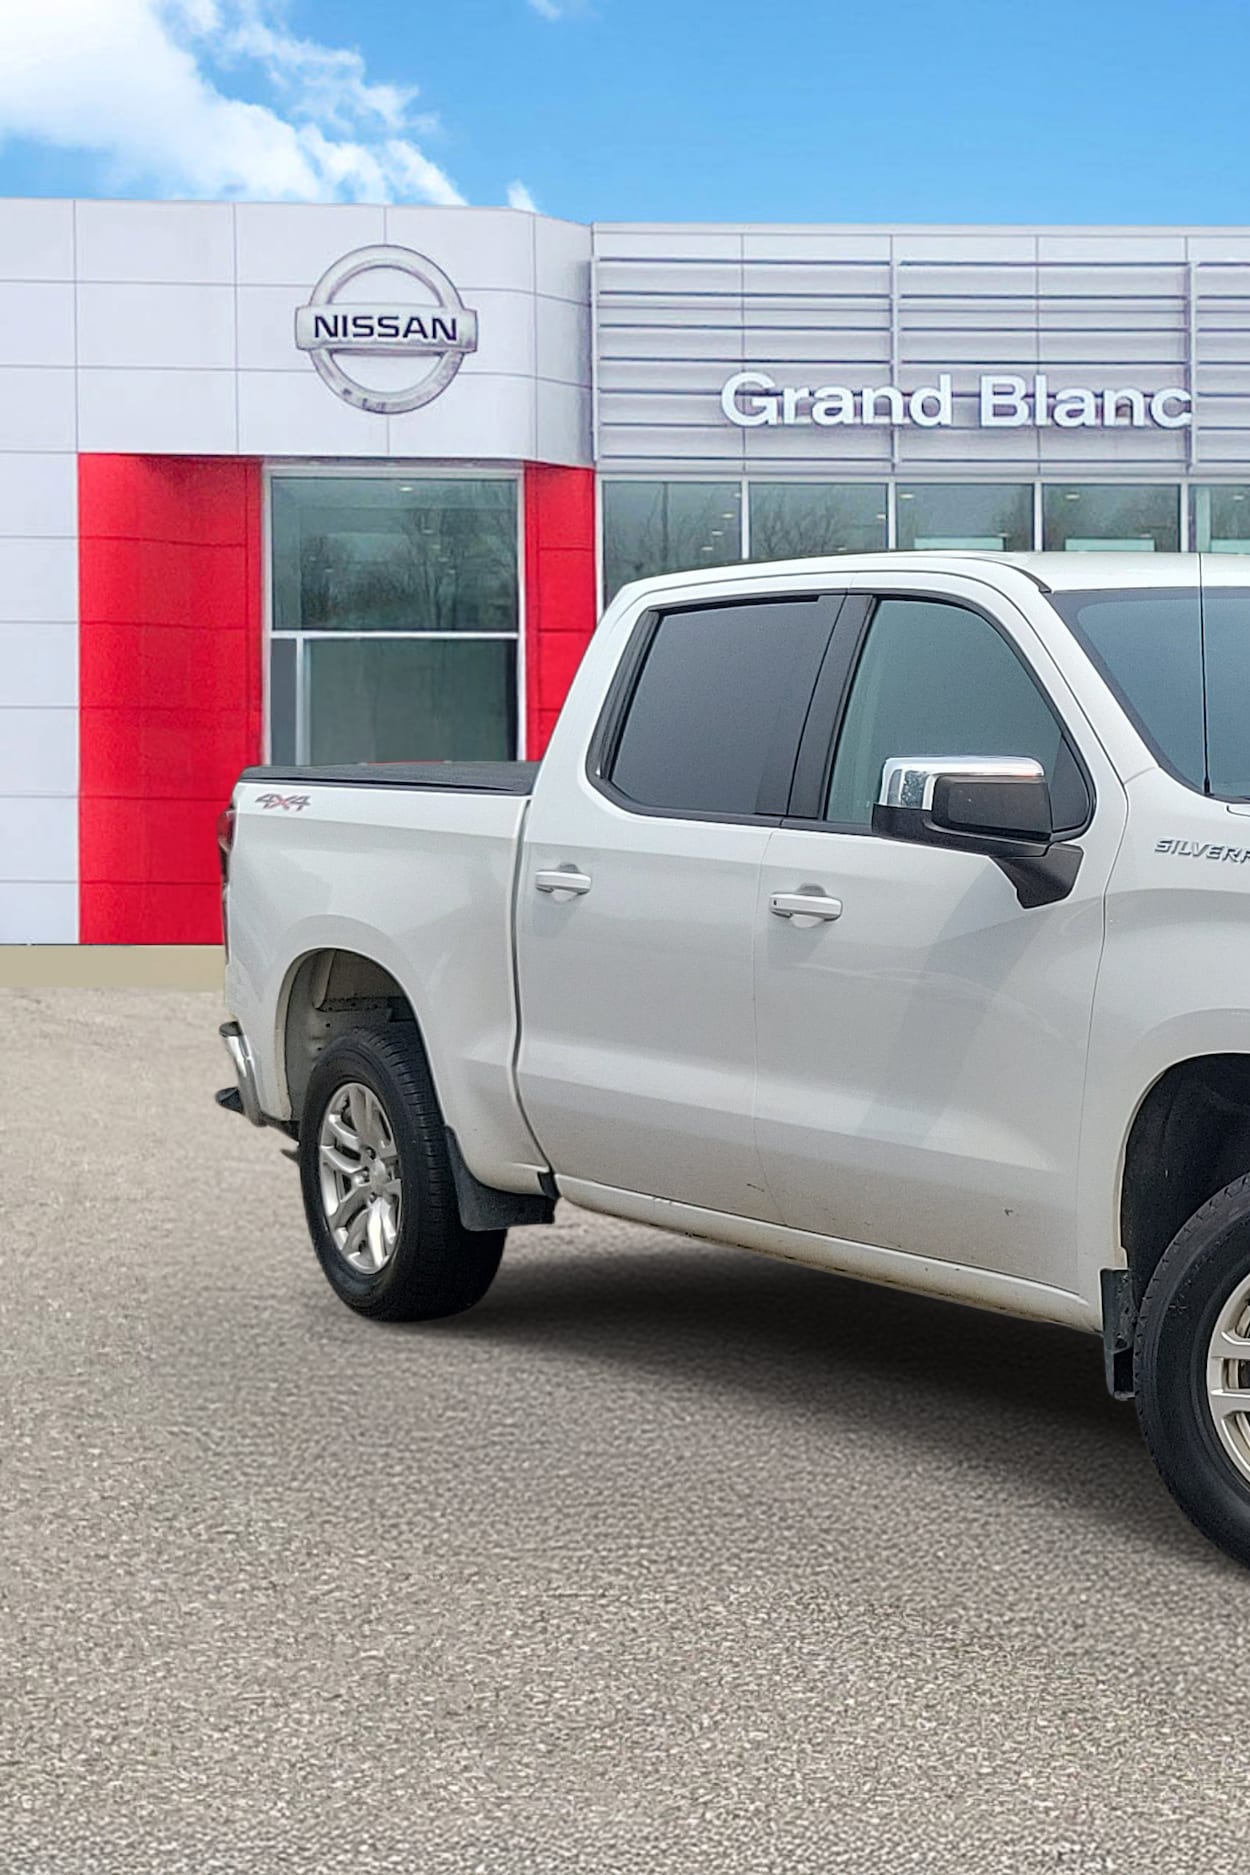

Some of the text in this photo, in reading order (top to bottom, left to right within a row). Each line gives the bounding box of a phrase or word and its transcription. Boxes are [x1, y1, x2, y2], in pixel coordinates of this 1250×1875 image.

[314, 314, 457, 341] NISSAN
[720, 372, 1193, 428] Grand Blanc
